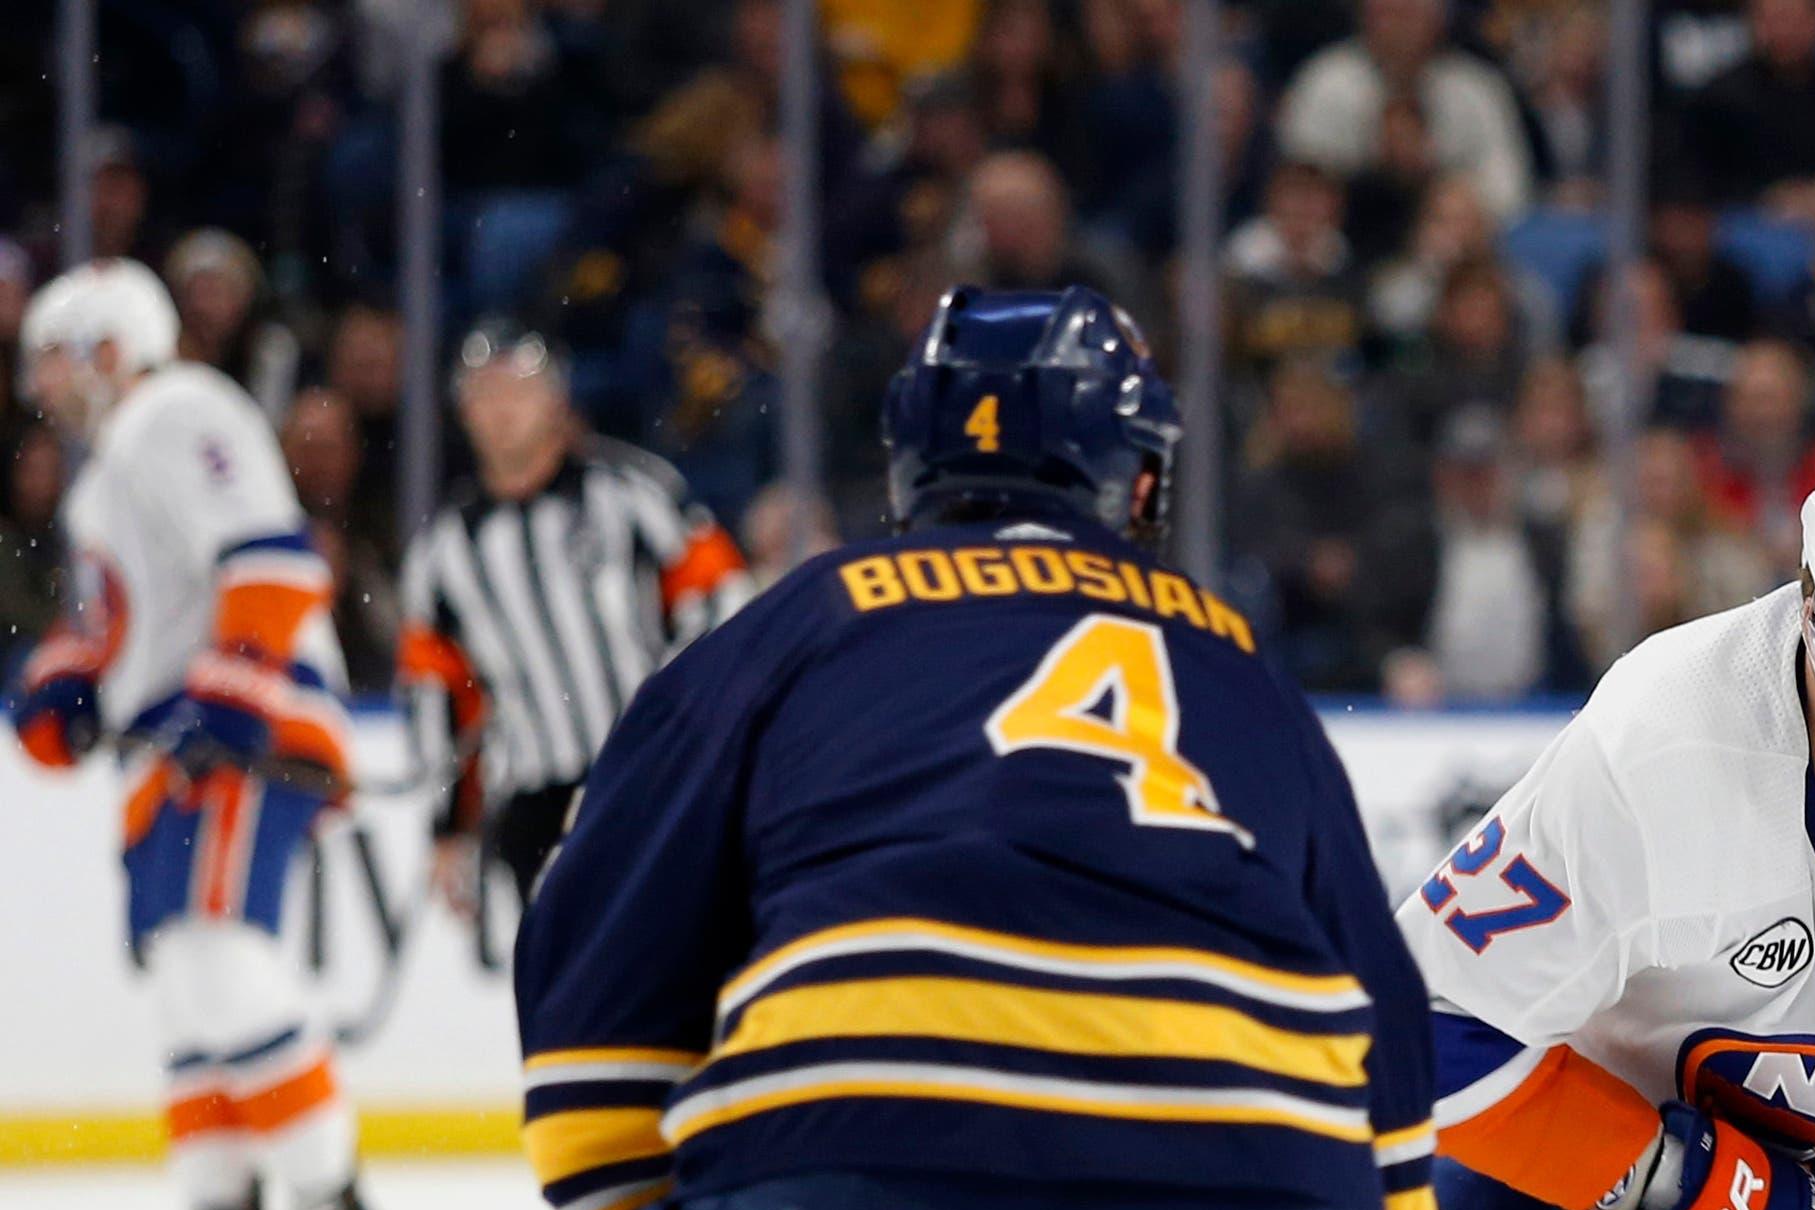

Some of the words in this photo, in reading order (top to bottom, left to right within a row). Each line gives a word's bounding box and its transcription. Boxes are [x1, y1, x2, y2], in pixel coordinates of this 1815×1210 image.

[964, 395, 1000, 452] 4
[838, 546, 1256, 655] BOGOSIAN
[983, 612, 1256, 850] 4
[1420, 815, 1572, 956] 27
[1738, 937, 1807, 973] CBW
